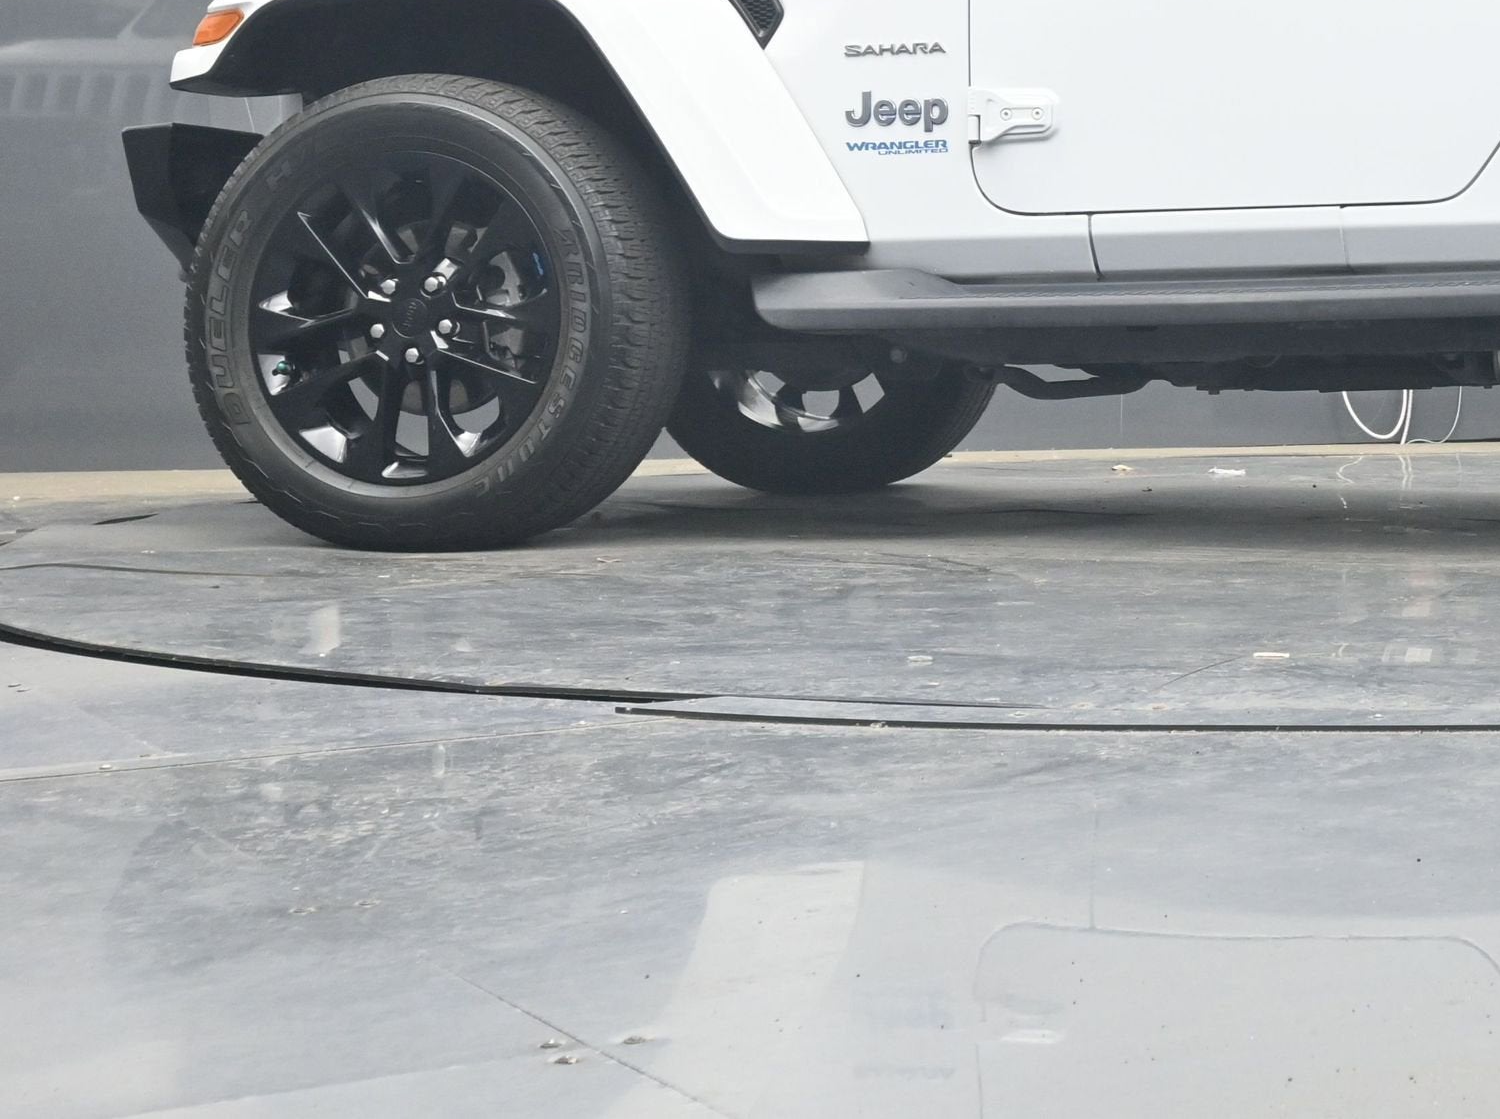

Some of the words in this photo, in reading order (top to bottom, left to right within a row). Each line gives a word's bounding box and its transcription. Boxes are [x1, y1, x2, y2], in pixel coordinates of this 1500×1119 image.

[844, 42, 947, 58] SAHARA
[845, 91, 949, 132] Jeep
[845, 139, 948, 152] WRANGLER
[877, 147, 949, 156] UNLIMITED
[207, 209, 250, 425] DUELER
